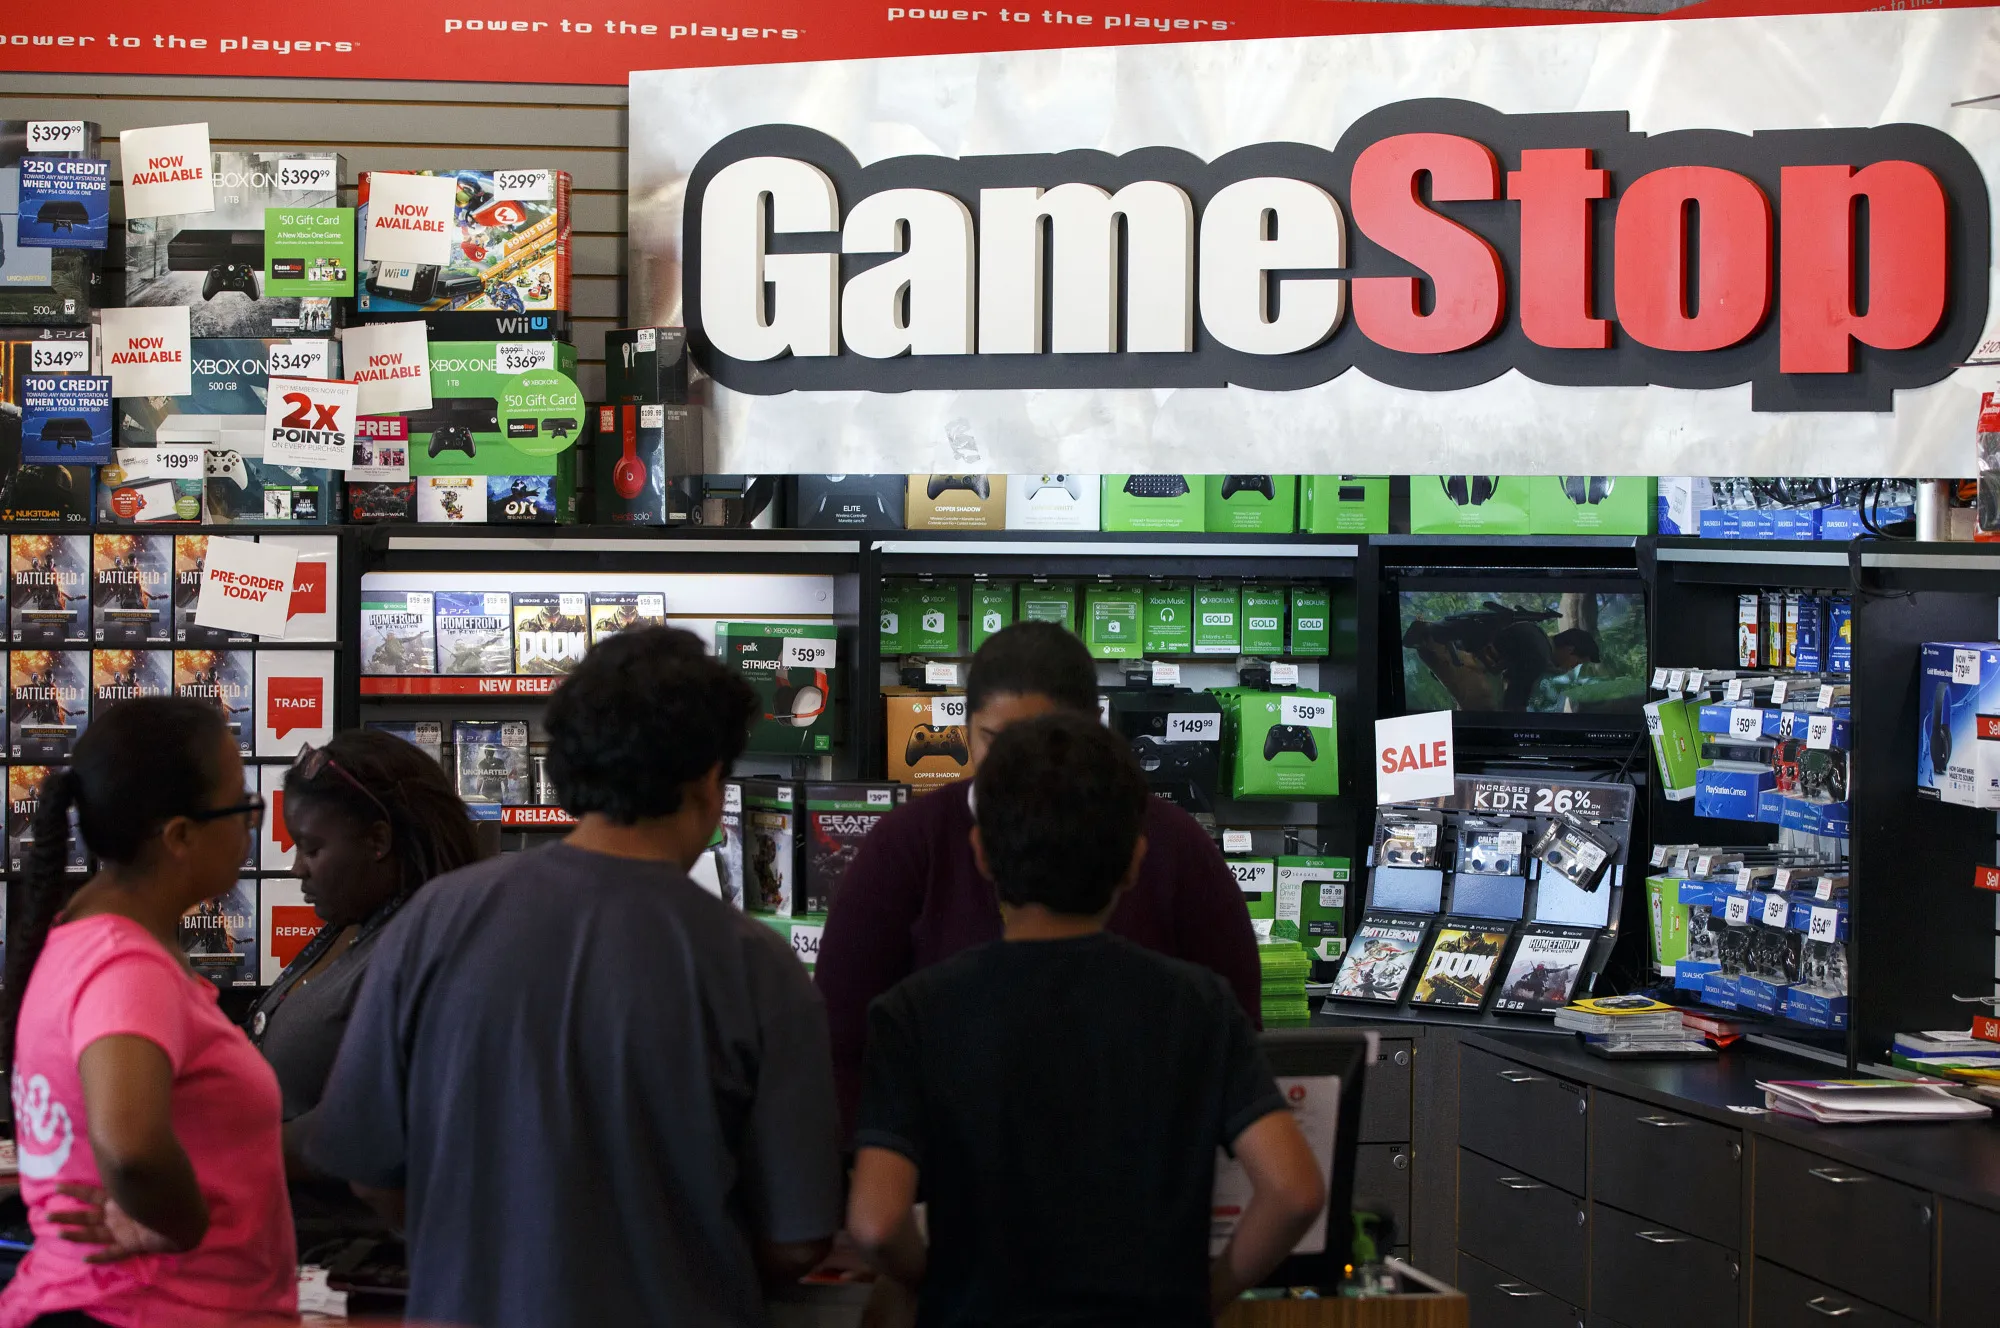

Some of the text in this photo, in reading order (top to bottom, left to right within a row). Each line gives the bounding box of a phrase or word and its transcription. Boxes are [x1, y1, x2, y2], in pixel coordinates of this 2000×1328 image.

[888, 8, 1228, 32] power to the players
[445, 19, 798, 41] power to the players
[107, 33, 140, 48] to
[153, 34, 207, 49] the
[220, 37, 352, 55] players
[23, 161, 107, 175] $250 CREDIT
[148, 156, 183, 170] NOW
[132, 167, 203, 185] AVAILABLE
[23, 180, 107, 190] WHEN YOU TRADE
[228, 196, 240, 204] TB
[394, 204, 428, 216] NOW
[296, 215, 314, 225] Gift
[316, 215, 340, 225] Card
[375, 216, 445, 233] AVAILABLE
[507, 228, 536, 248] BONUS
[700, 132, 1951, 374] GameStop
[496, 316, 529, 334] Wii
[129, 337, 163, 349] NOW
[111, 351, 182, 364] AVAILABLE
[527, 348, 545, 356] Now
[369, 353, 403, 367] NOW
[191, 359, 239, 375] XBOX
[353, 365, 421, 382] AVAILABLE
[26, 378, 109, 391] $100 CREDIT
[208, 382, 237, 391] 500 GB
[290, 385, 319, 394] MEMBERS
[450, 379, 460, 387] TB
[79, 399, 109, 407] TRADE
[505, 393, 577, 407] $50 Gift Card
[356, 420, 401, 436] FREE
[272, 428, 346, 446] POINTS
[282, 442, 307, 450] EVERY
[308, 444, 346, 453] PURCHASE
[16, 572, 85, 585] BATTLEFIELD 1
[99, 571, 160, 584] BATTLEFIELD
[163, 572, 168, 584] 1
[210, 569, 284, 592] PRE-ORDER
[223, 585, 268, 602] TODAY
[1150, 597, 1185, 605] Xbox Music
[369, 614, 423, 626] HOMEFRONT
[440, 617, 502, 630] HOMEFRONT
[1205, 615, 1231, 624] GOLD
[1251, 619, 1275, 628] GOLD
[1300, 620, 1321, 628] GOLD
[518, 631, 586, 668] DOOM
[742, 660, 781, 670] STRIKER
[180, 685, 248, 698] BATTLEFIELD 1
[479, 680, 511, 692] NEW
[16, 687, 85, 700] BATTLEFIELD 1
[274, 698, 316, 708] TRADE
[1381, 740, 1447, 774] SALE
[1476, 783, 1531, 794] INCREASES
[1730, 787, 1747, 796] Camera
[1474, 788, 1591, 814] KDR 26%
[818, 815, 882, 825] GEARS
[184, 916, 252, 929] BATTLEFIELD 1
[275, 926, 322, 936] REPEAT
[1359, 926, 1420, 943] BATTLEBORN
[1528, 939, 1580, 949] HOMEFRONT
[1425, 952, 1494, 985] DOOM
